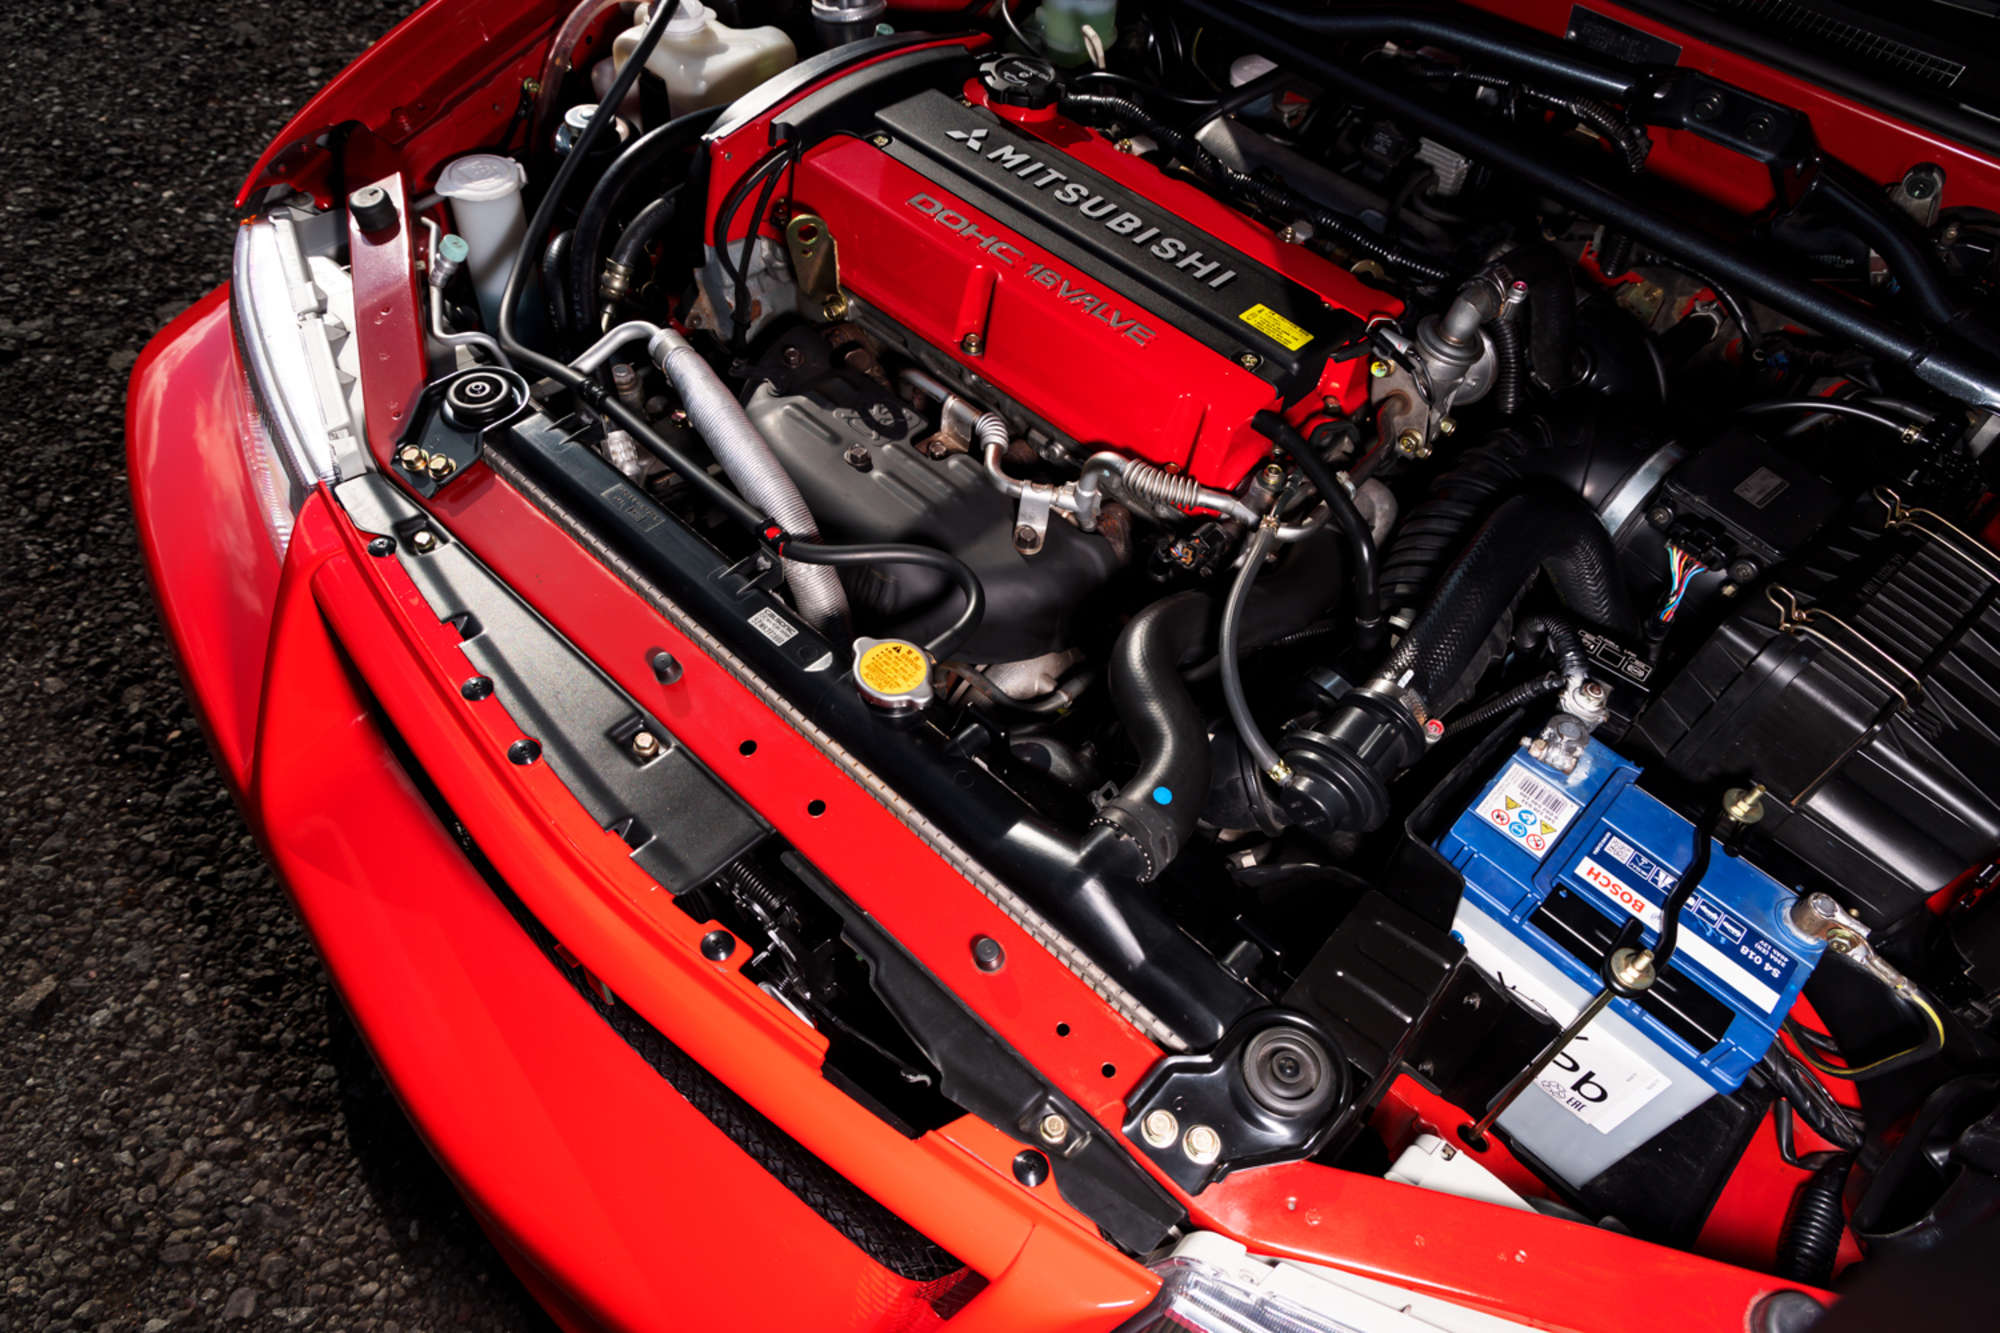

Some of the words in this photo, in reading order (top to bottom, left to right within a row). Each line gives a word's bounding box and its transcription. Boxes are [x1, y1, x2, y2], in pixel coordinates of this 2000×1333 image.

[906, 193, 1024, 264] DOHC
[986, 145, 1236, 288] MITSUBISHI
[1586, 867, 1645, 914] BOSCH
[1740, 944, 1763, 965] 018
[1763, 962, 1781, 978] S4
